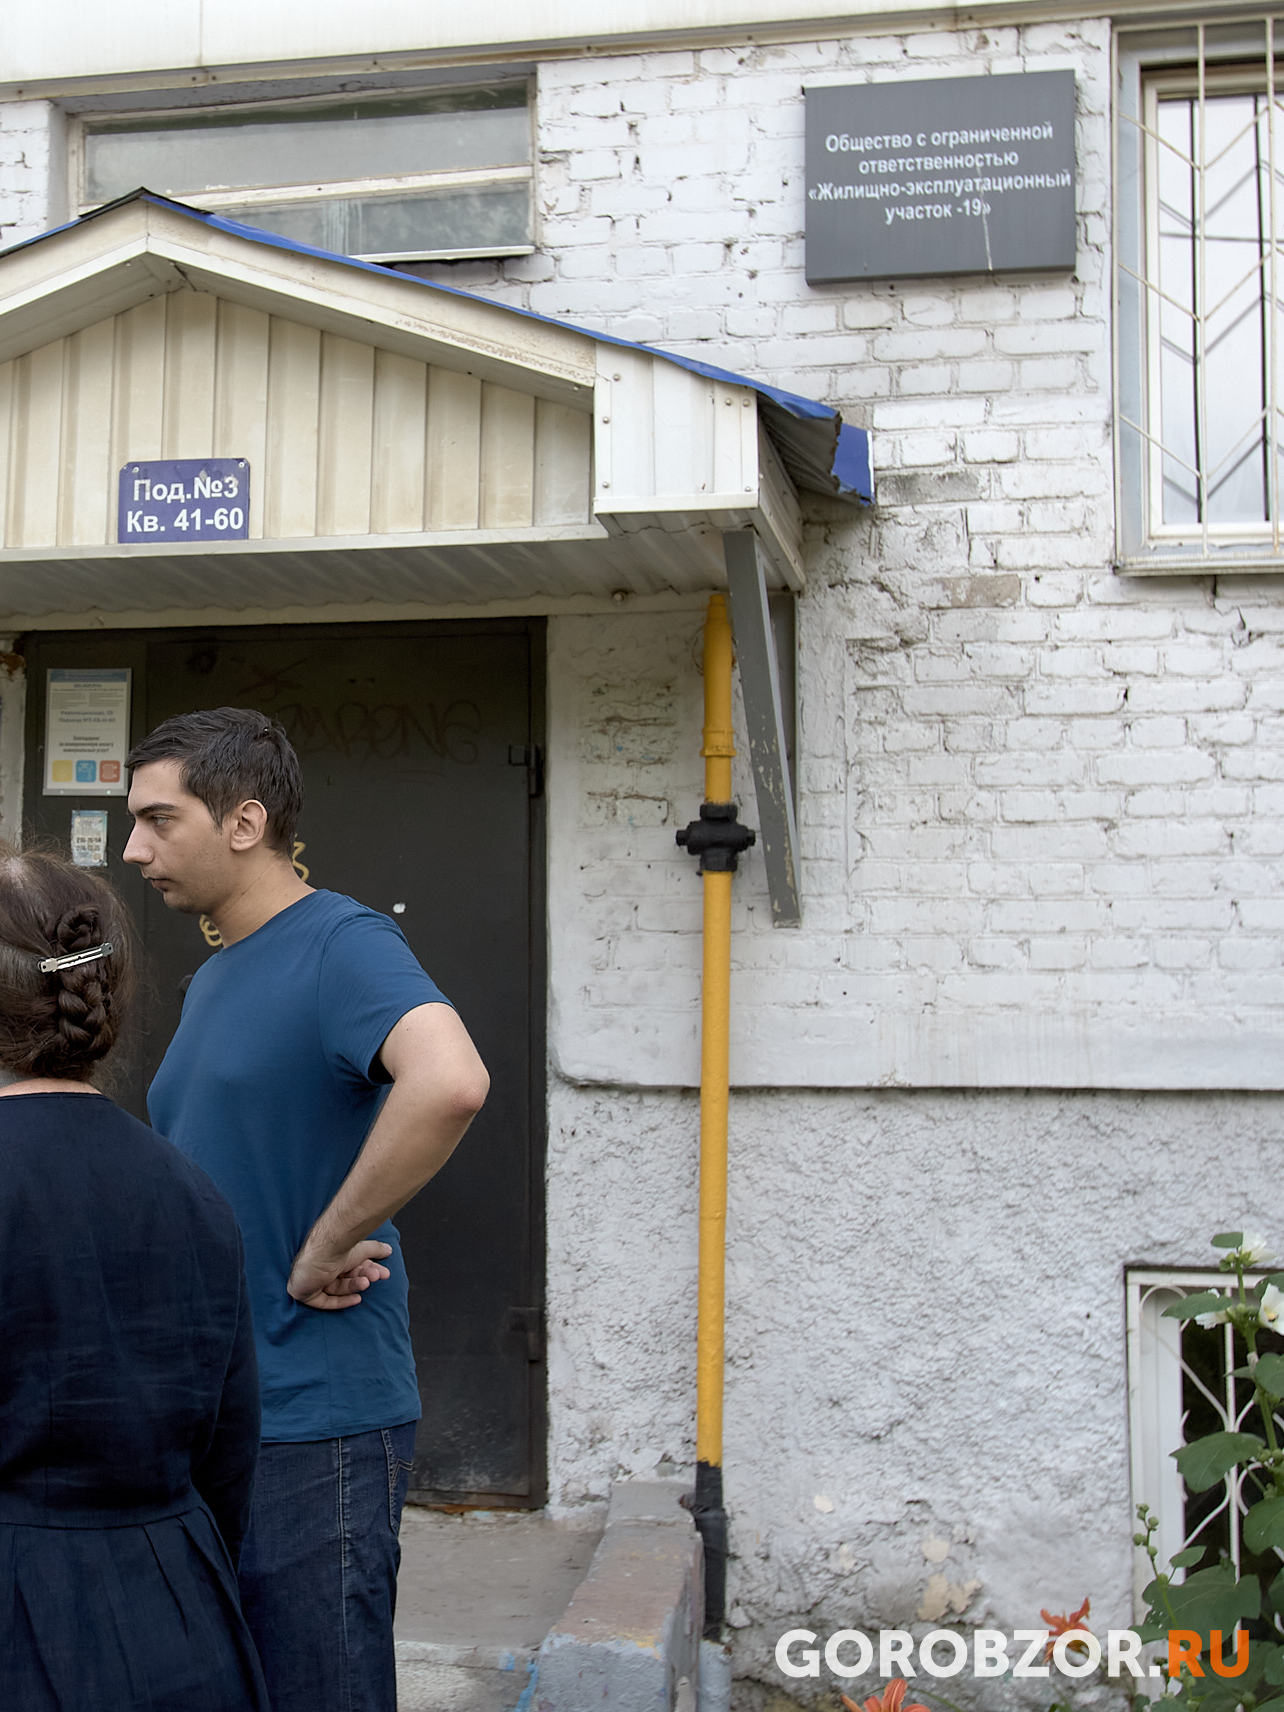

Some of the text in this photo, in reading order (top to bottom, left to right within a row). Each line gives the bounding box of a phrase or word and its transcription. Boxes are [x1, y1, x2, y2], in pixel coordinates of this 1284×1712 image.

[825, 120, 1053, 153] Общество с ограниченной
[858, 150, 1019, 174] ответственностью
[808, 168, 1071, 201] «Жилищно-эксплуатационный
[885, 198, 992, 225] участок -19»
[126, 507, 244, 533] Кв. 41-60
